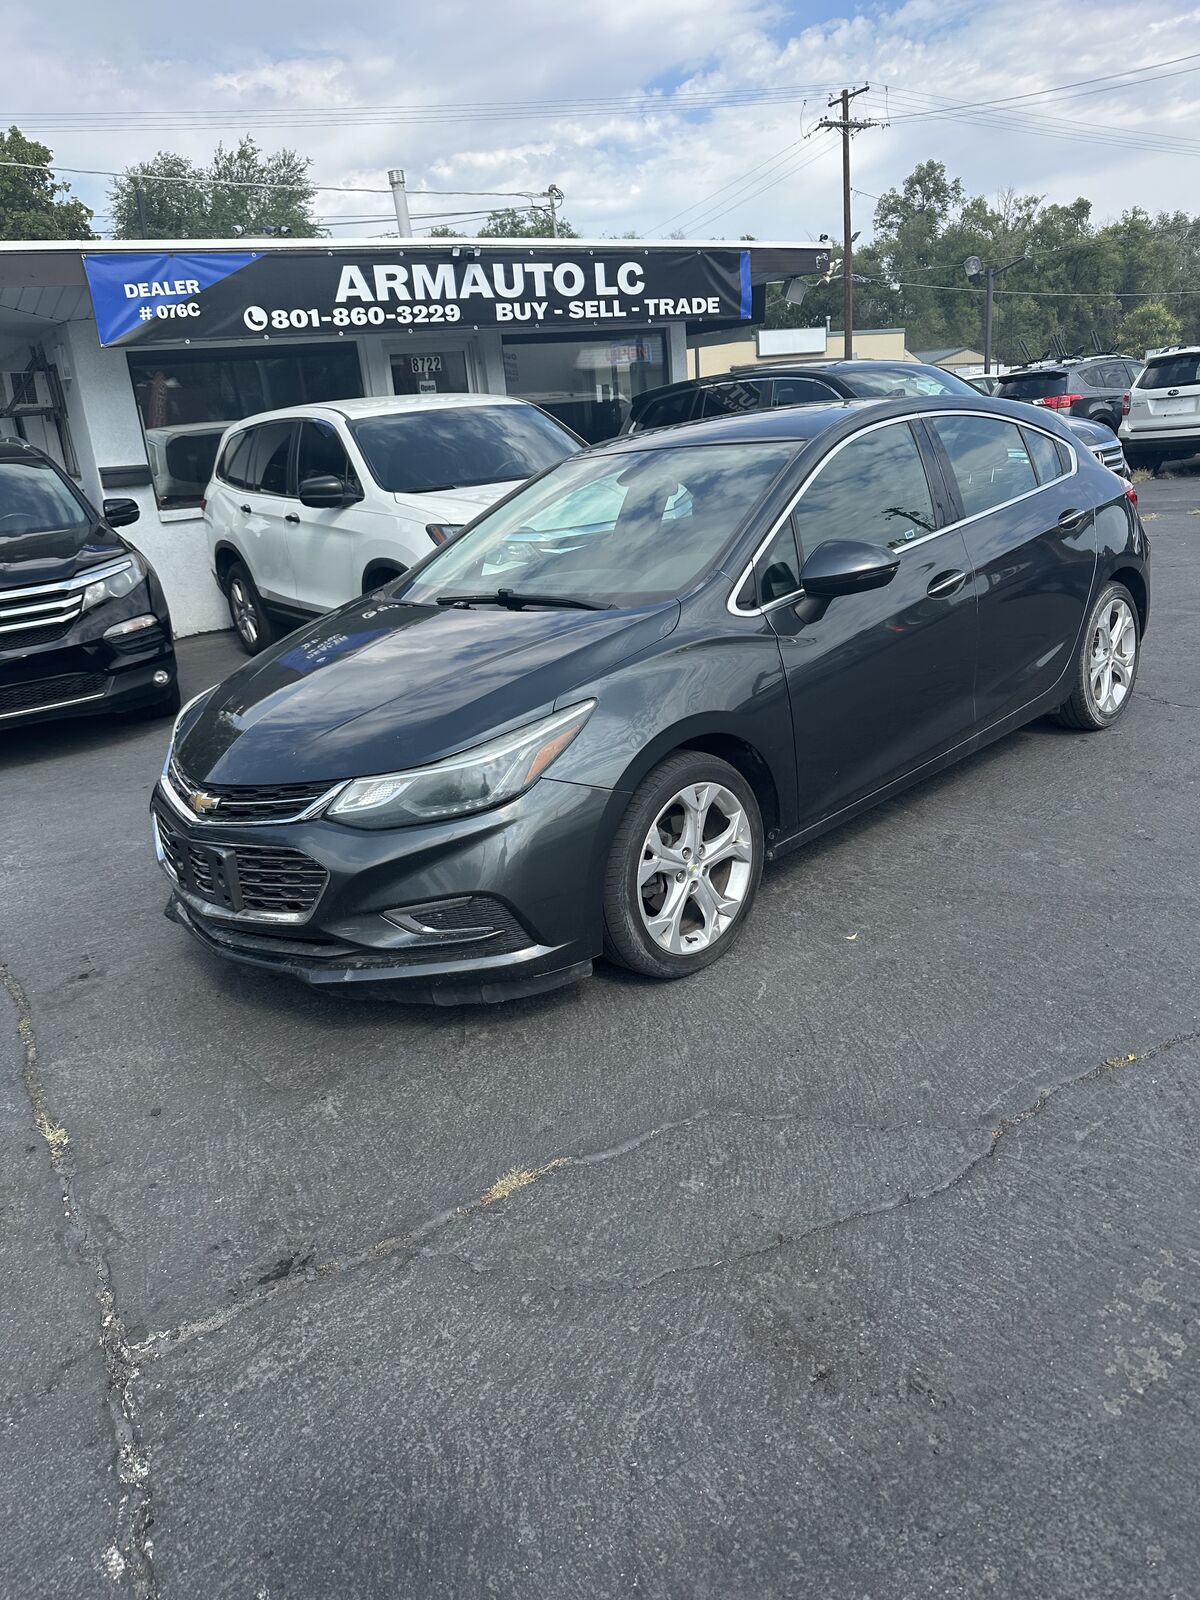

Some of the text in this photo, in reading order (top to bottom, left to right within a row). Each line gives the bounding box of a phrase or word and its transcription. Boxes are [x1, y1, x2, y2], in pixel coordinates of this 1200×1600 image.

[123, 279, 201, 299] DEALER
[335, 261, 646, 303] ARMAUTO LC
[139, 302, 201, 321] # 076C
[271, 303, 460, 329] 801-860-3229
[495, 301, 549, 322] BUY
[568, 300, 627, 319] SELL
[644, 296, 720, 317] TRADE
[412, 357, 441, 372] 8722
